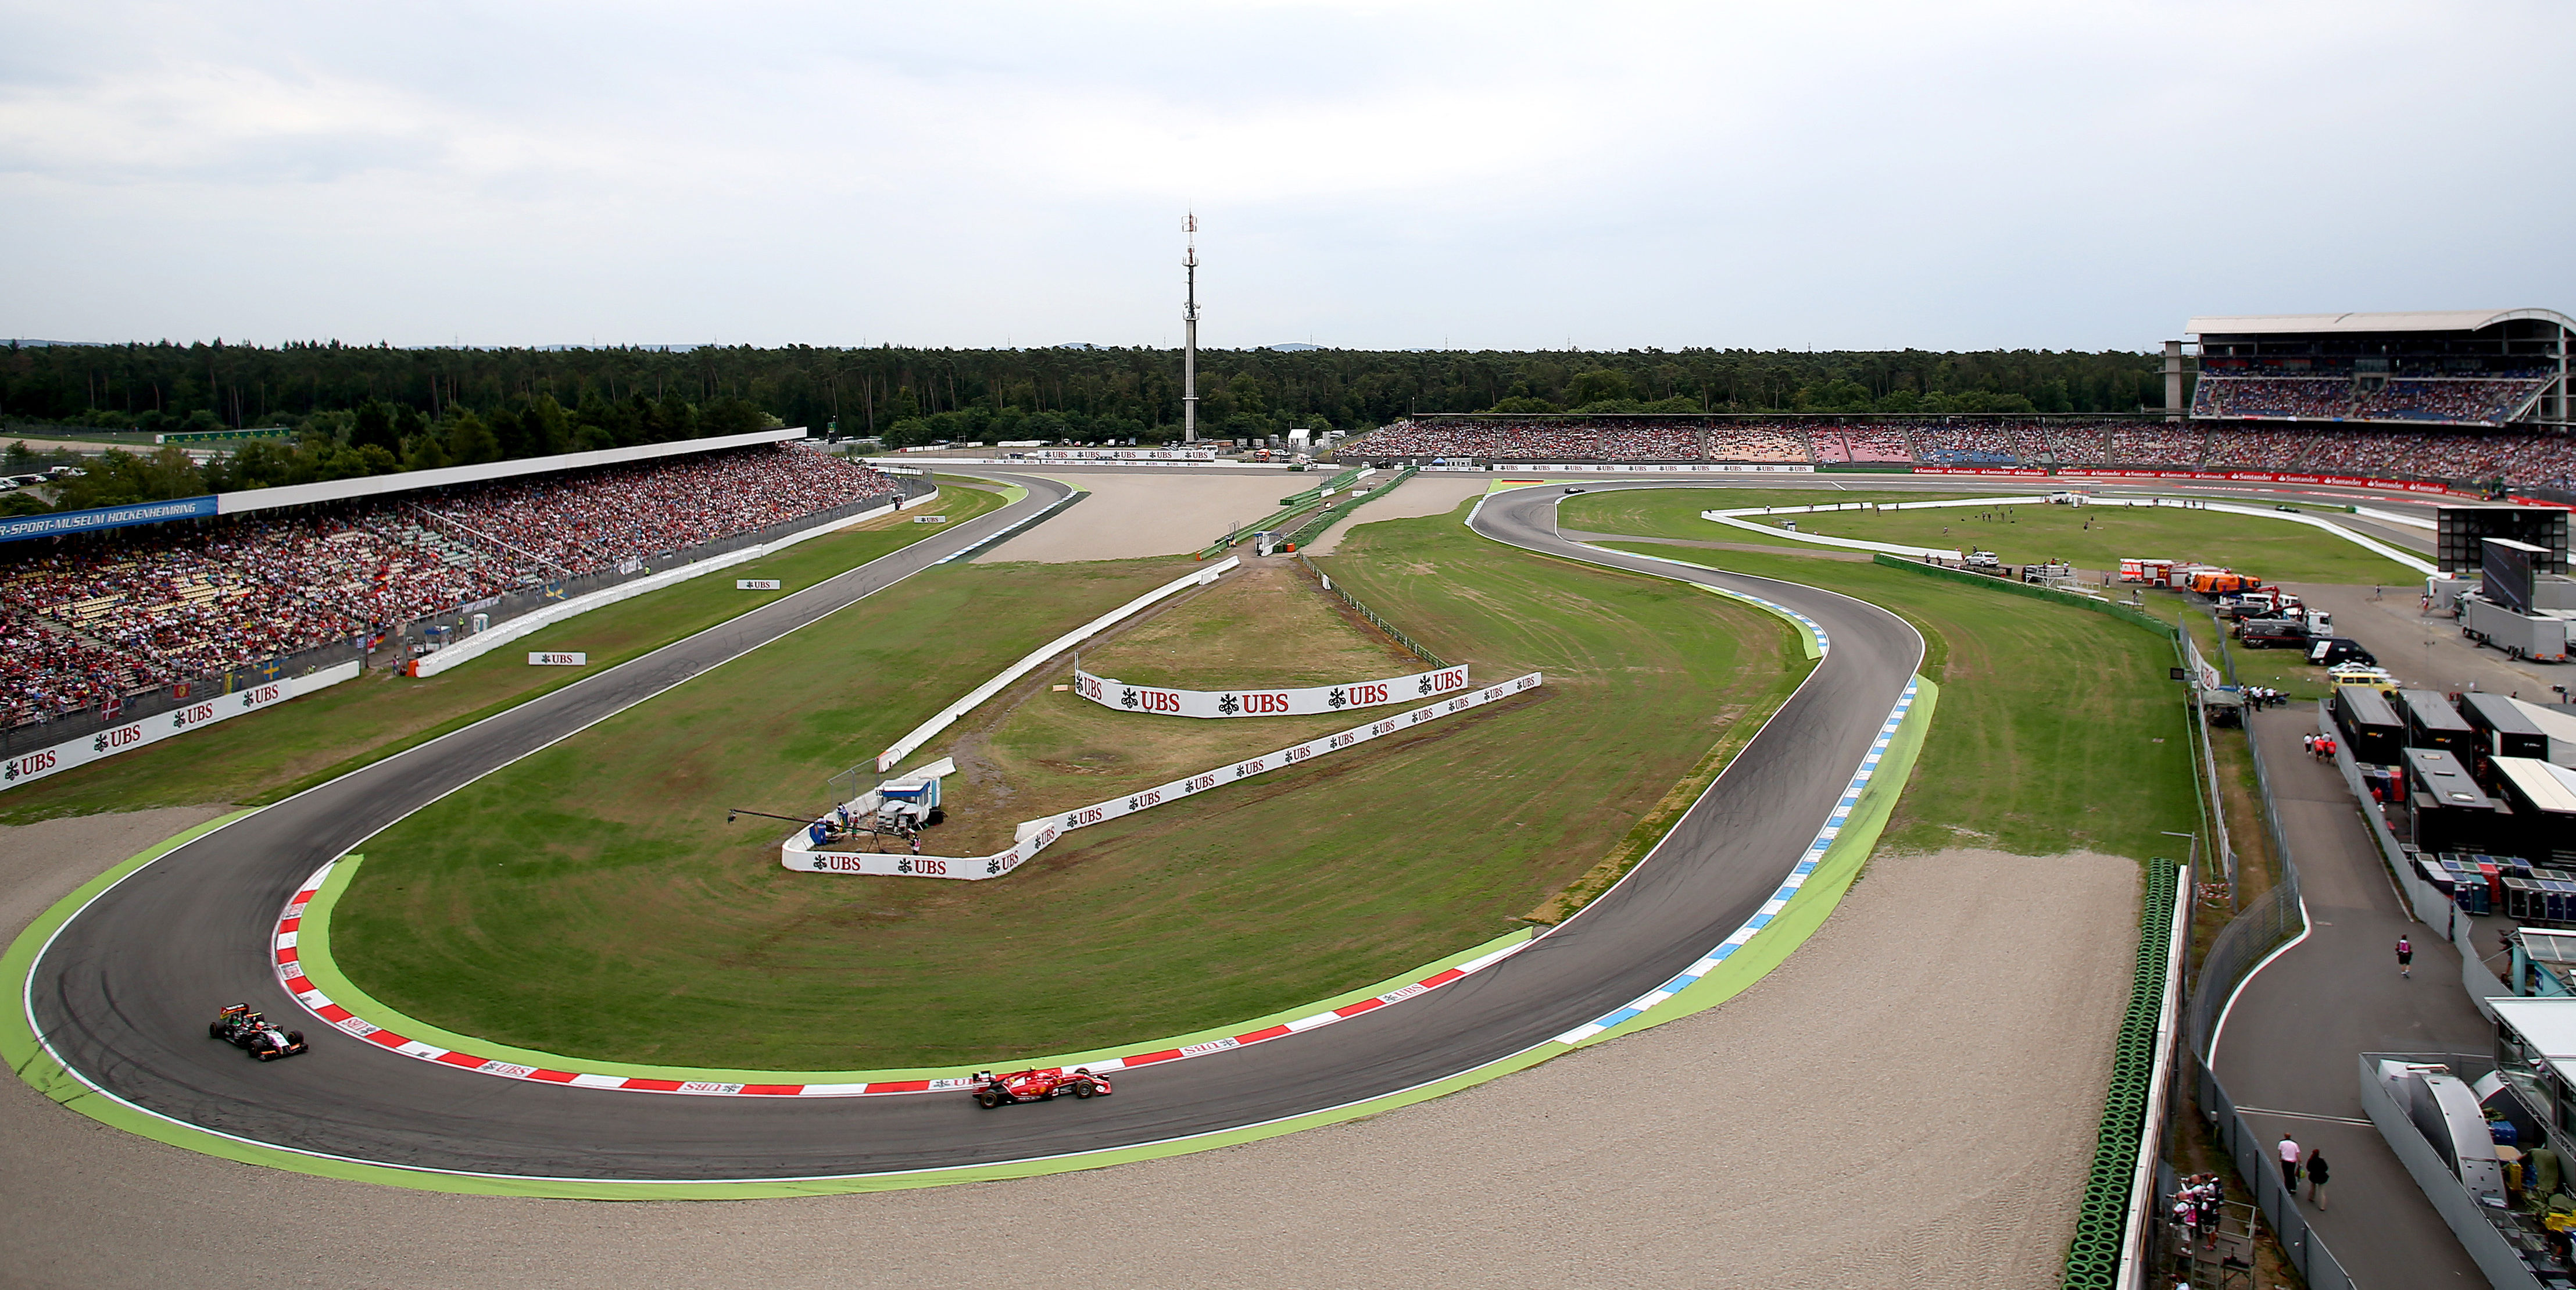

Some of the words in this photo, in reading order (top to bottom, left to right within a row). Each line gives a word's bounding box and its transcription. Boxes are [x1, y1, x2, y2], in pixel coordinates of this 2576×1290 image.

[2239, 473, 2272, 481] Santander
[2286, 474, 2319, 484] Santander
[2332, 477, 2362, 487] Santander
[2375, 480, 2404, 490] Santander
[2415, 483, 2443, 493] Santander
[108, 503, 196, 523] HOCKENHEIMRING
[552, 655, 573, 664] UBS
[1084, 676, 1102, 700] UBS
[1140, 691, 1180, 712] UBS
[1243, 694, 1289, 713] UBS
[1348, 684, 1388, 705] UBS
[1433, 670, 1463, 691] UBS
[22, 750, 56, 775] UBS
[110, 724, 141, 747] UBS
[188, 703, 213, 724] UBS
[256, 684, 279, 704] UBS
[830, 856, 860, 870] UBS
[915, 860, 946, 874] UBS
[1002, 851, 1018, 870] UBS
[1042, 827, 1055, 845] UBS
[1079, 808, 1102, 825] UBS
[1139, 791, 1161, 806] UBS
[1194, 774, 1215, 790] UBS
[1245, 760, 1264, 774] UBS
[1293, 745, 1311, 760] UBS
[1337, 732, 1354, 746] UBS
[1379, 720, 1395, 734] UBS
[1418, 708, 1433, 720] UBS
[1455, 696, 1469, 709] UBS
[1489, 687, 1503, 699] UBS
[1522, 676, 1535, 688] UBS
[1394, 985, 1423, 996] UBS
[1184, 1042, 1220, 1053] UBS
[496, 1064, 530, 1075] UBS
[684, 1083, 721, 1091] UBS
